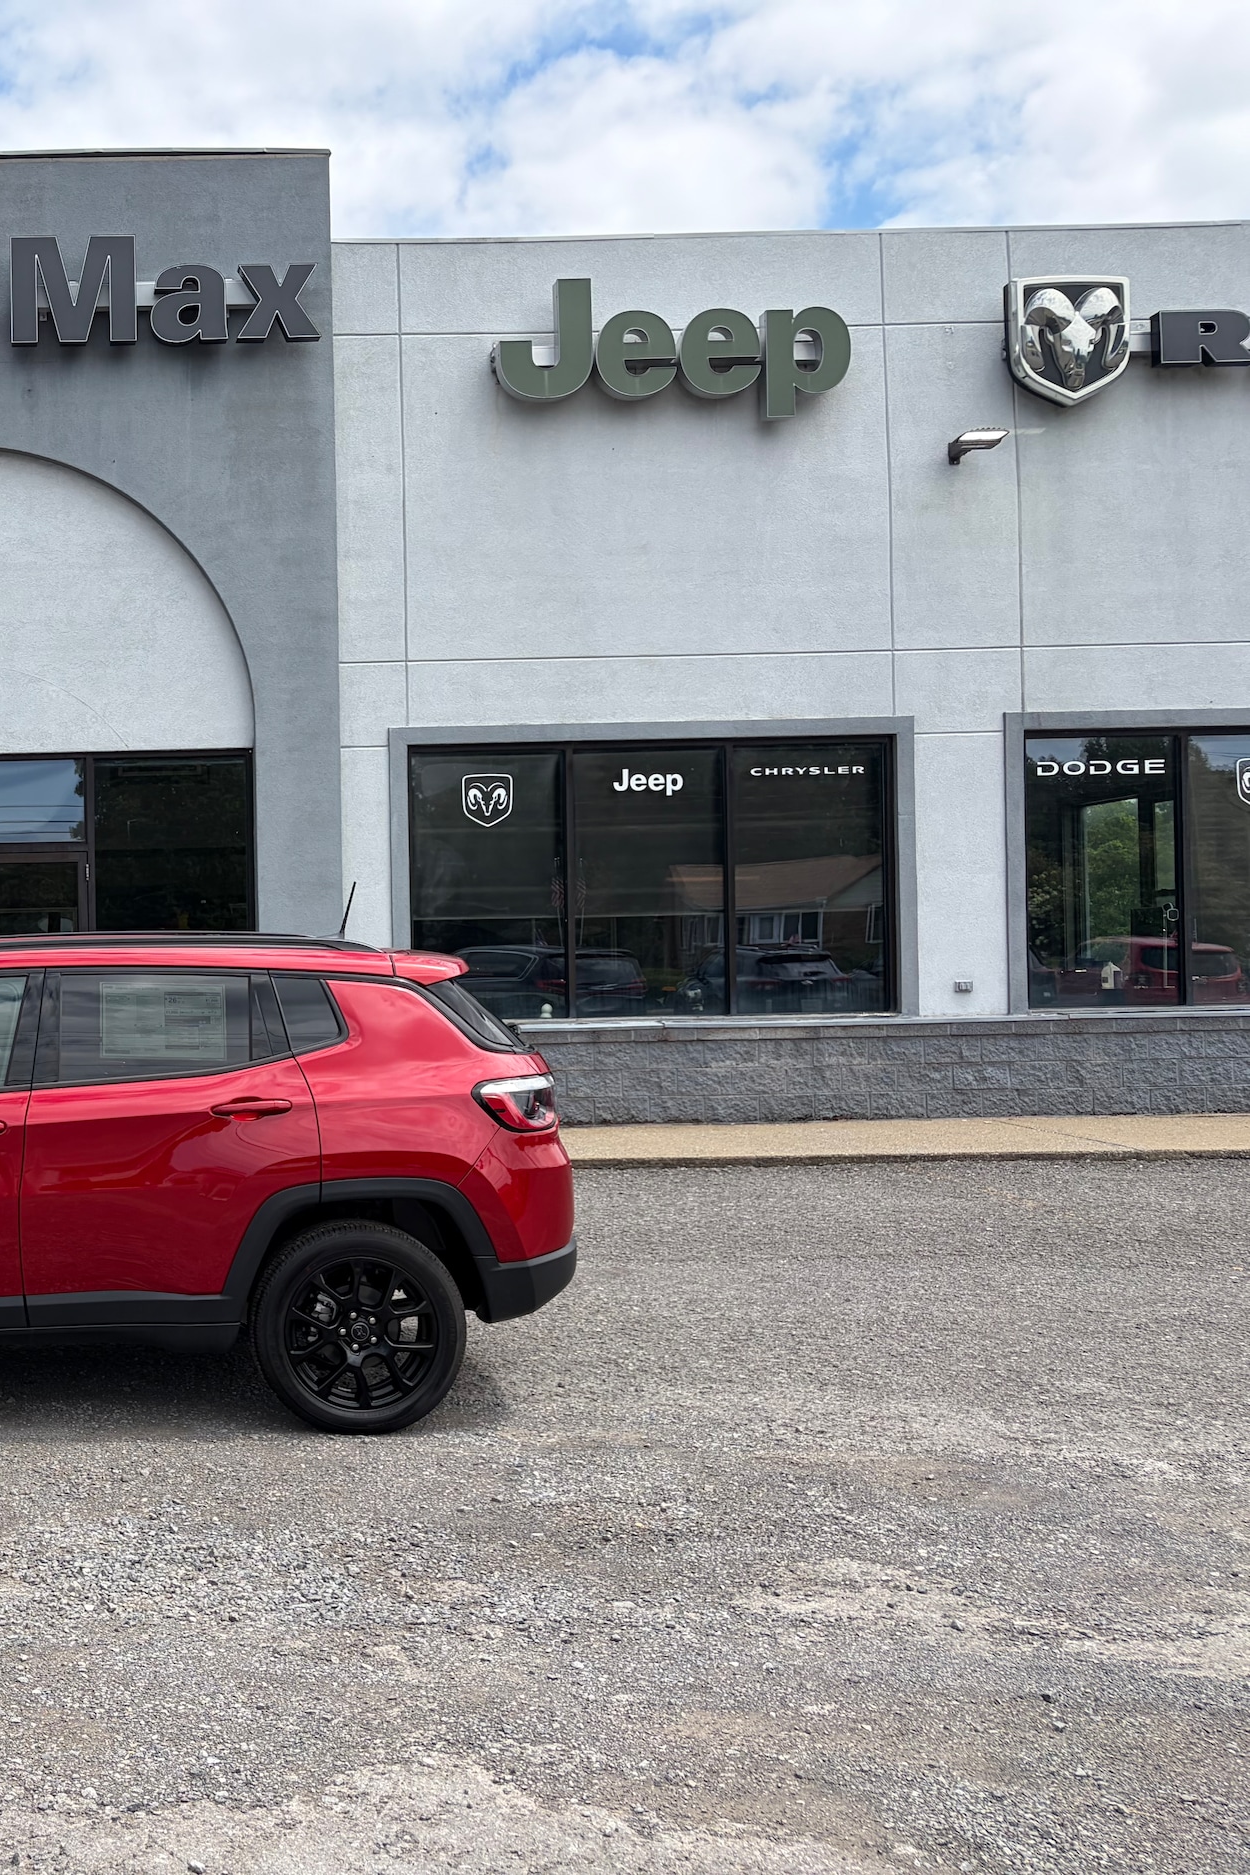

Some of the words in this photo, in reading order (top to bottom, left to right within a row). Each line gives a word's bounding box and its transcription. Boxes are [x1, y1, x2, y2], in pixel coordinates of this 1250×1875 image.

[9, 234, 321, 347] Max
[495, 278, 851, 420] Jeep
[750, 765, 865, 777] CHRYSLER
[1036, 759, 1166, 776] DODGE
[612, 768, 684, 796] Jeep
